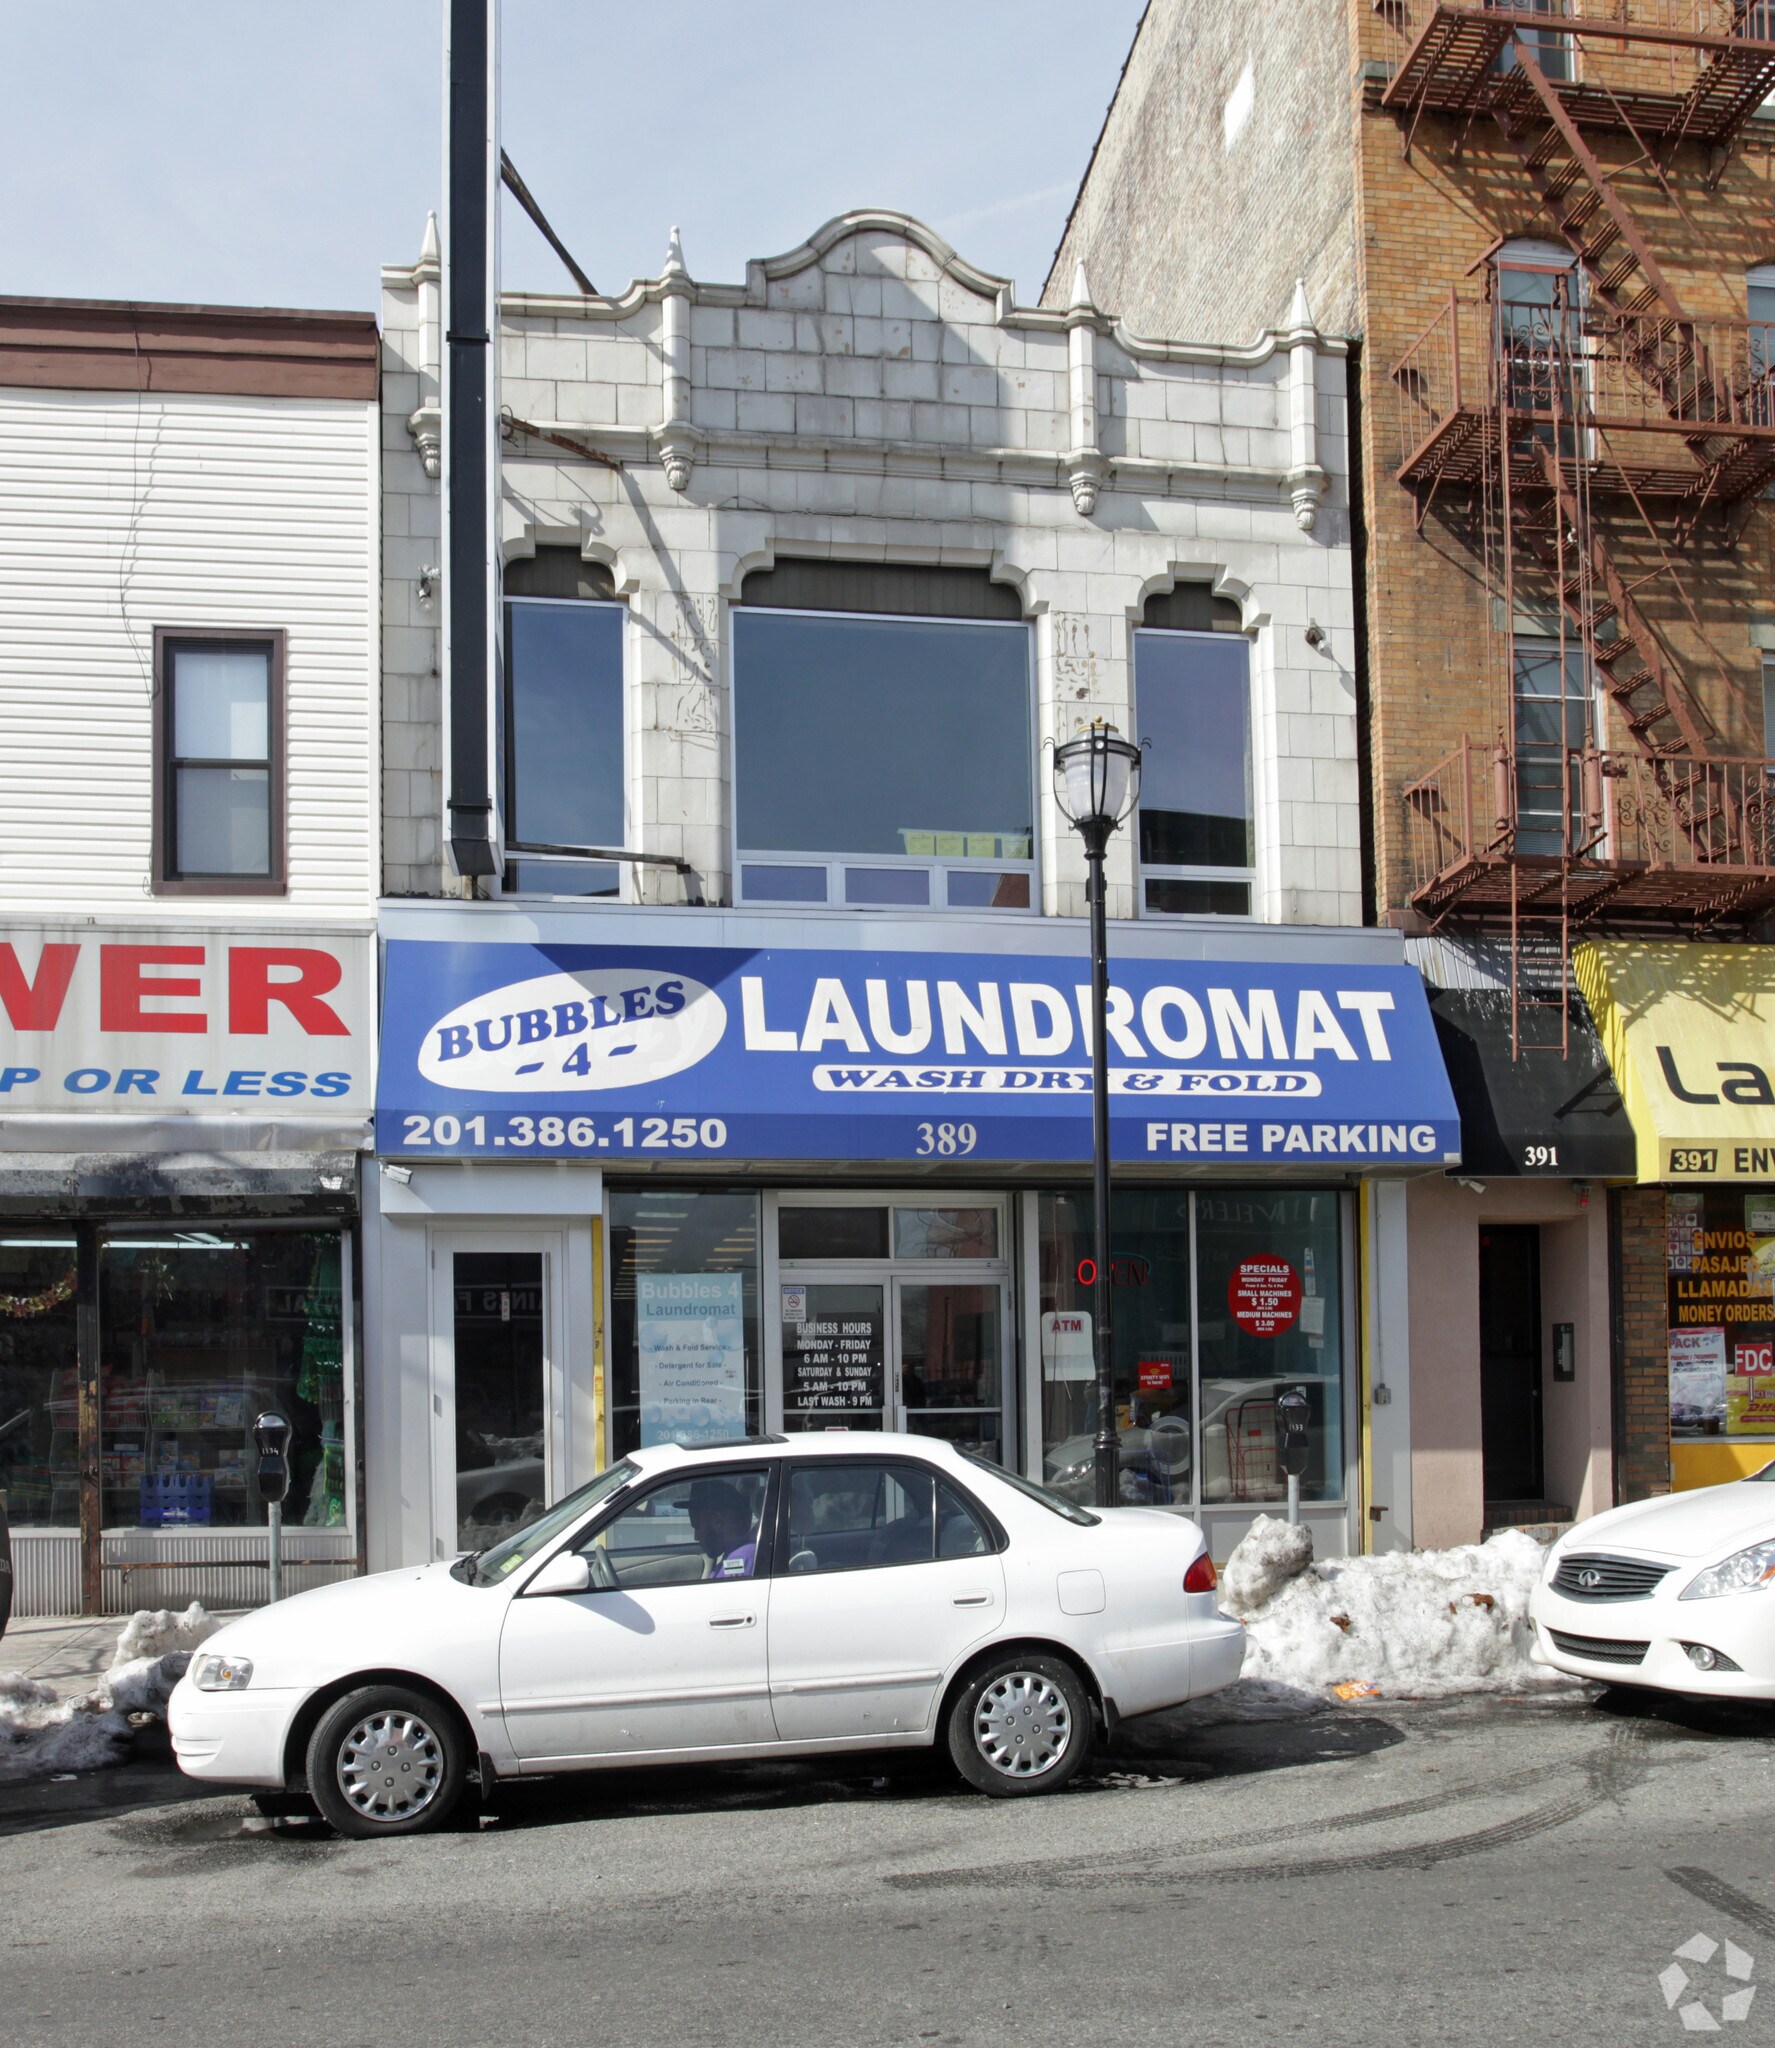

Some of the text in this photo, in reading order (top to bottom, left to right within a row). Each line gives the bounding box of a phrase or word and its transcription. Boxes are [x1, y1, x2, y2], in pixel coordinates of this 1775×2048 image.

[437, 980, 686, 1062] BUBBLES
[741, 976, 1396, 1062] LAUNDROMAT
[562, 1042, 592, 1076] 4
[63, 1068, 160, 1094] OR
[181, 1070, 352, 1097] LESS
[827, 1070, 987, 1088] WASH
[1122, 1074, 1163, 1091] &
[1176, 1075, 1308, 1092] FOLD
[402, 1115, 727, 1148] 201.386.1250
[915, 1123, 977, 1155] 389
[1147, 1123, 1437, 1153] FREE PARKING
[1525, 1147, 1559, 1166] 391
[1674, 1147, 1775, 1173] 391 EN
[1693, 1231, 1757, 1249] ENVIOS
[1077, 1258, 1149, 1286] OEN
[1240, 1264, 1290, 1273] SPECIALS
[1692, 1255, 1760, 1274] PASAJES
[641, 1281, 740, 1299] Bubbles 4
[1260, 1290, 1293, 1298] MACHINES
[1678, 1280, 1774, 1298] LLAMADAS
[646, 1303, 736, 1317] Laundromat
[1259, 1297, 1279, 1306] 1.50
[1679, 1303, 1774, 1322] MONEY ORDERS
[796, 1322, 872, 1334] BUSINESS HOURS
[1052, 1319, 1082, 1332] ATM
[796, 1339, 833, 1350] MONDAY
[840, 1339, 871, 1350] FRIDAY
[659, 1362, 693, 1370] Detergent
[803, 1354, 810, 1363] 6
[813, 1353, 829, 1363] AM
[837, 1353, 849, 1363] 10
[851, 1353, 867, 1363] PM
[797, 1367, 833, 1377] SATURDAY
[844, 1367, 872, 1377] SUNDAY
[803, 1382, 809, 1391] 5
[812, 1382, 828, 1391] AM
[837, 1382, 849, 1391] 10
[851, 1382, 867, 1391] PM
[797, 1396, 819, 1406] LAST
[821, 1396, 846, 1406] WASH
[852, 1396, 858, 1406] 9
[860, 1396, 872, 1406] PM
